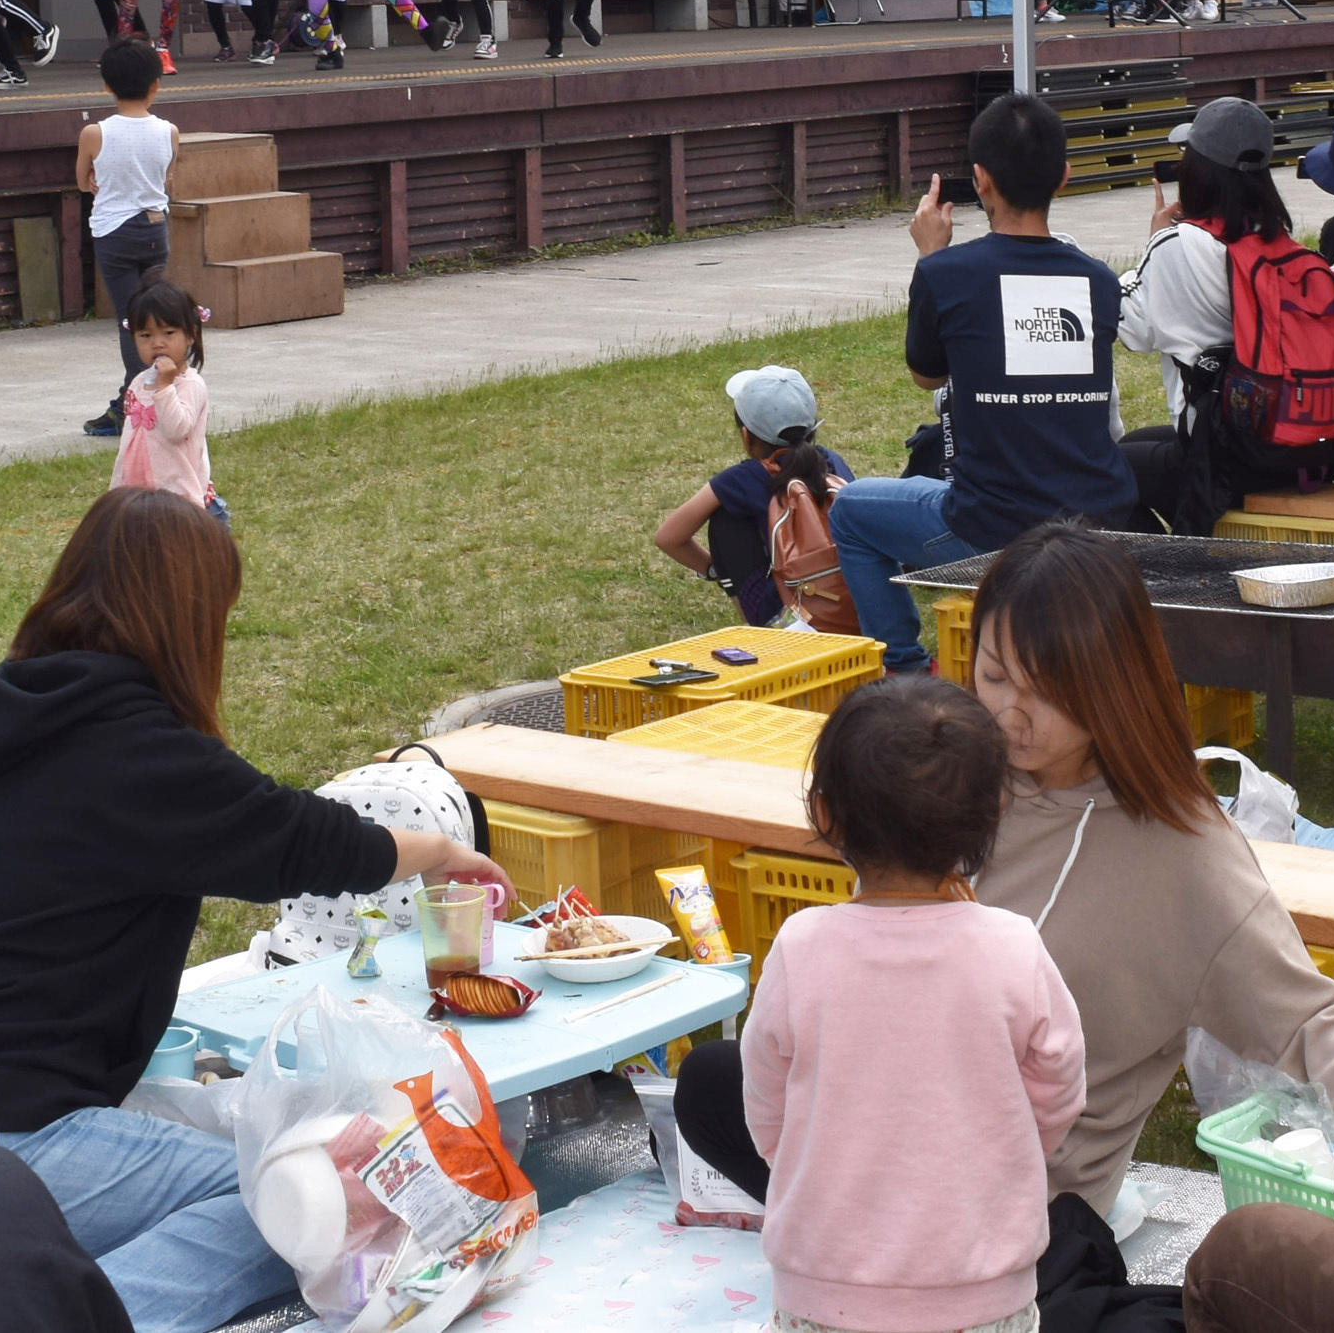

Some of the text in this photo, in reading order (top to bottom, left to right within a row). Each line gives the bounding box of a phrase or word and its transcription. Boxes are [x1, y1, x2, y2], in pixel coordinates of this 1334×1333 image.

[1033, 307, 1058, 318] THE
[1015, 319, 1060, 331] NORTH
[1029, 331, 1061, 342] FACE
[975, 391, 1109, 404] NEVER STOP EXPLORING
[384, 799, 402, 809] MCM
[405, 823, 424, 832] MCM
[395, 914, 412, 922] MCM
